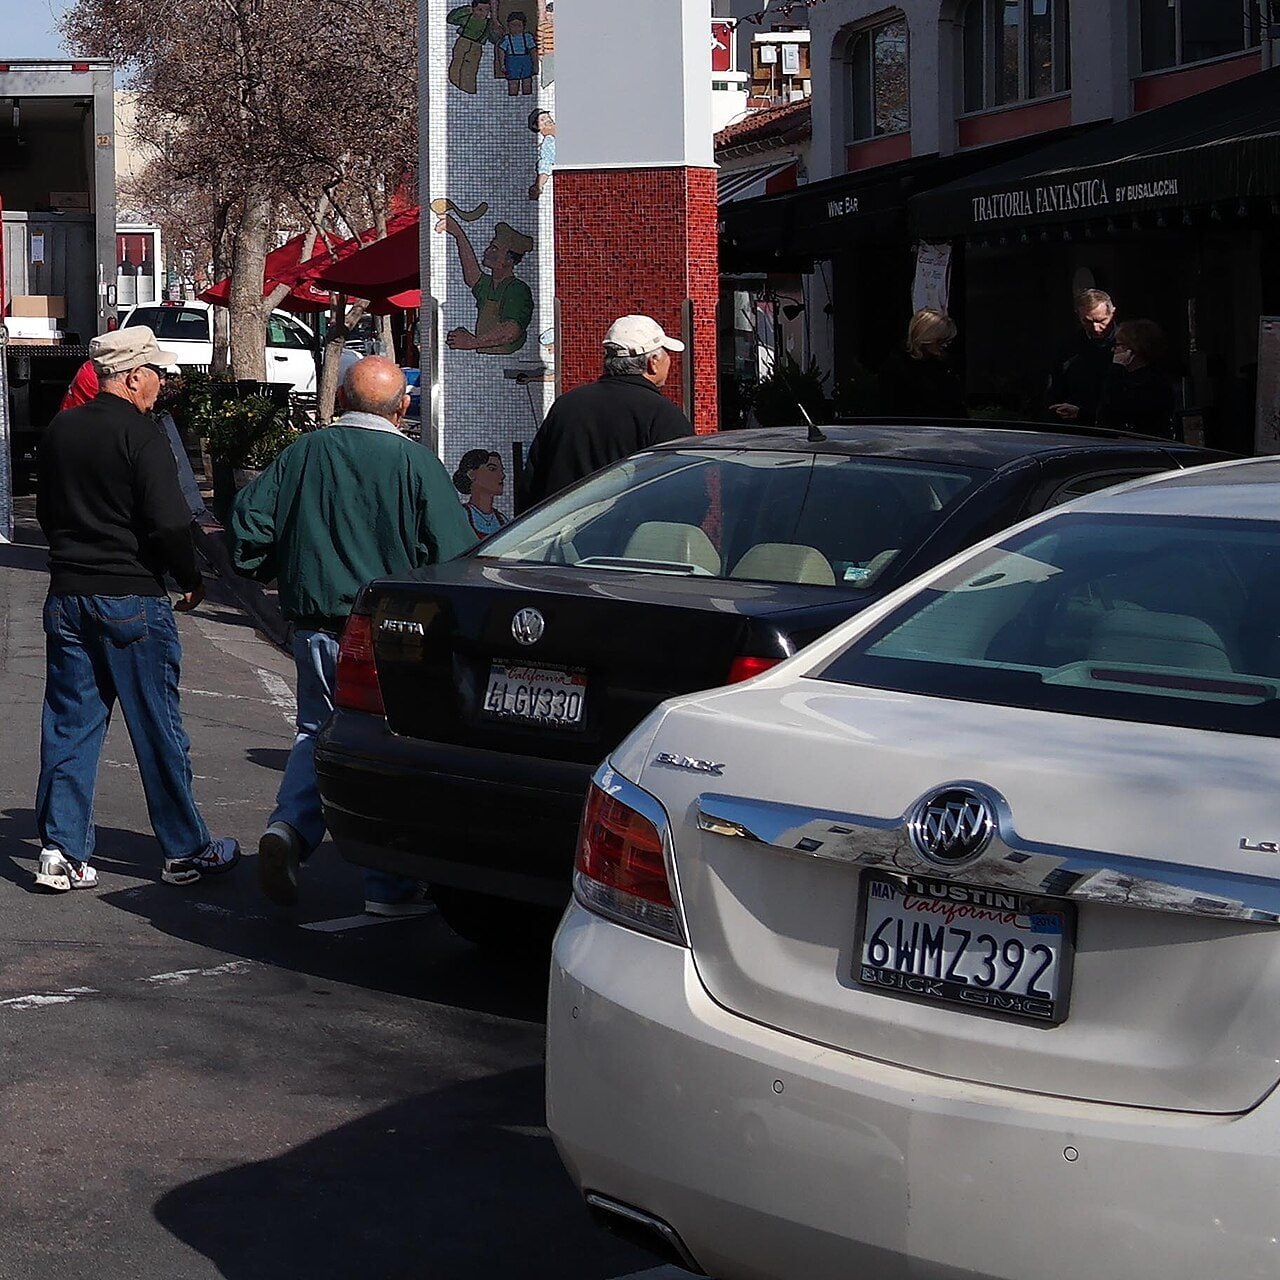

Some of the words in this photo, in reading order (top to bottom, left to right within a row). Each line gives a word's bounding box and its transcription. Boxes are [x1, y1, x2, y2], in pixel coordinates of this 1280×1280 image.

[972, 189, 1033, 222] TRATTORIA
[1035, 178, 1110, 214] FANTASTICA
[1115, 187, 1126, 202] BY
[1127, 179, 1178, 201] BUSALACCHI
[380, 619, 425, 636] JETTA
[508, 666, 571, 687] California
[488, 681, 581, 721] 4LGV330
[656, 751, 726, 775] BUICK
[871, 881, 897, 901] MAY
[912, 879, 1015, 909] TUSTIN
[902, 894, 1032, 930] California
[867, 917, 1054, 1001] 6WMZ392
[861, 967, 944, 997] BUICK
[959, 988, 1052, 1016] GMC
